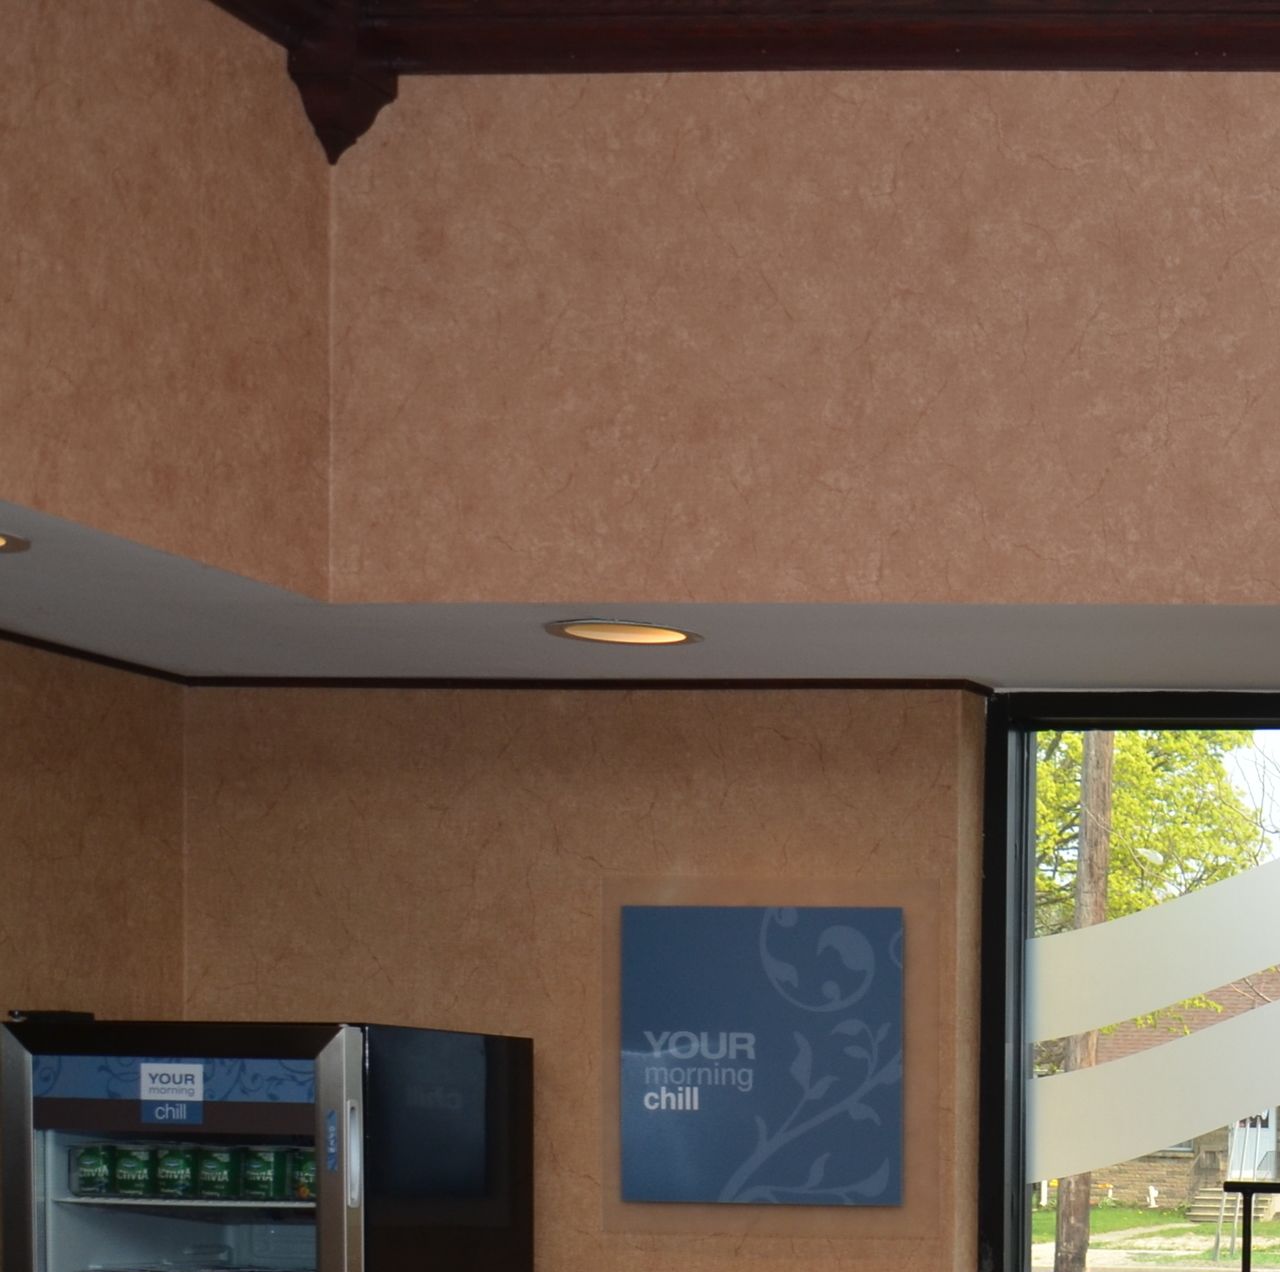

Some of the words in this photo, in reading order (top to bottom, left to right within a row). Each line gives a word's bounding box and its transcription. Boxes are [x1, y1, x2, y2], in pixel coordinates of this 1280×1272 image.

[644, 1031, 756, 1060] YOUR
[148, 1073, 195, 1085] YOUR
[645, 1063, 754, 1093] morning
[149, 1086, 195, 1097] morning
[644, 1086, 699, 1111] chill
[154, 1104, 187, 1120] chill
